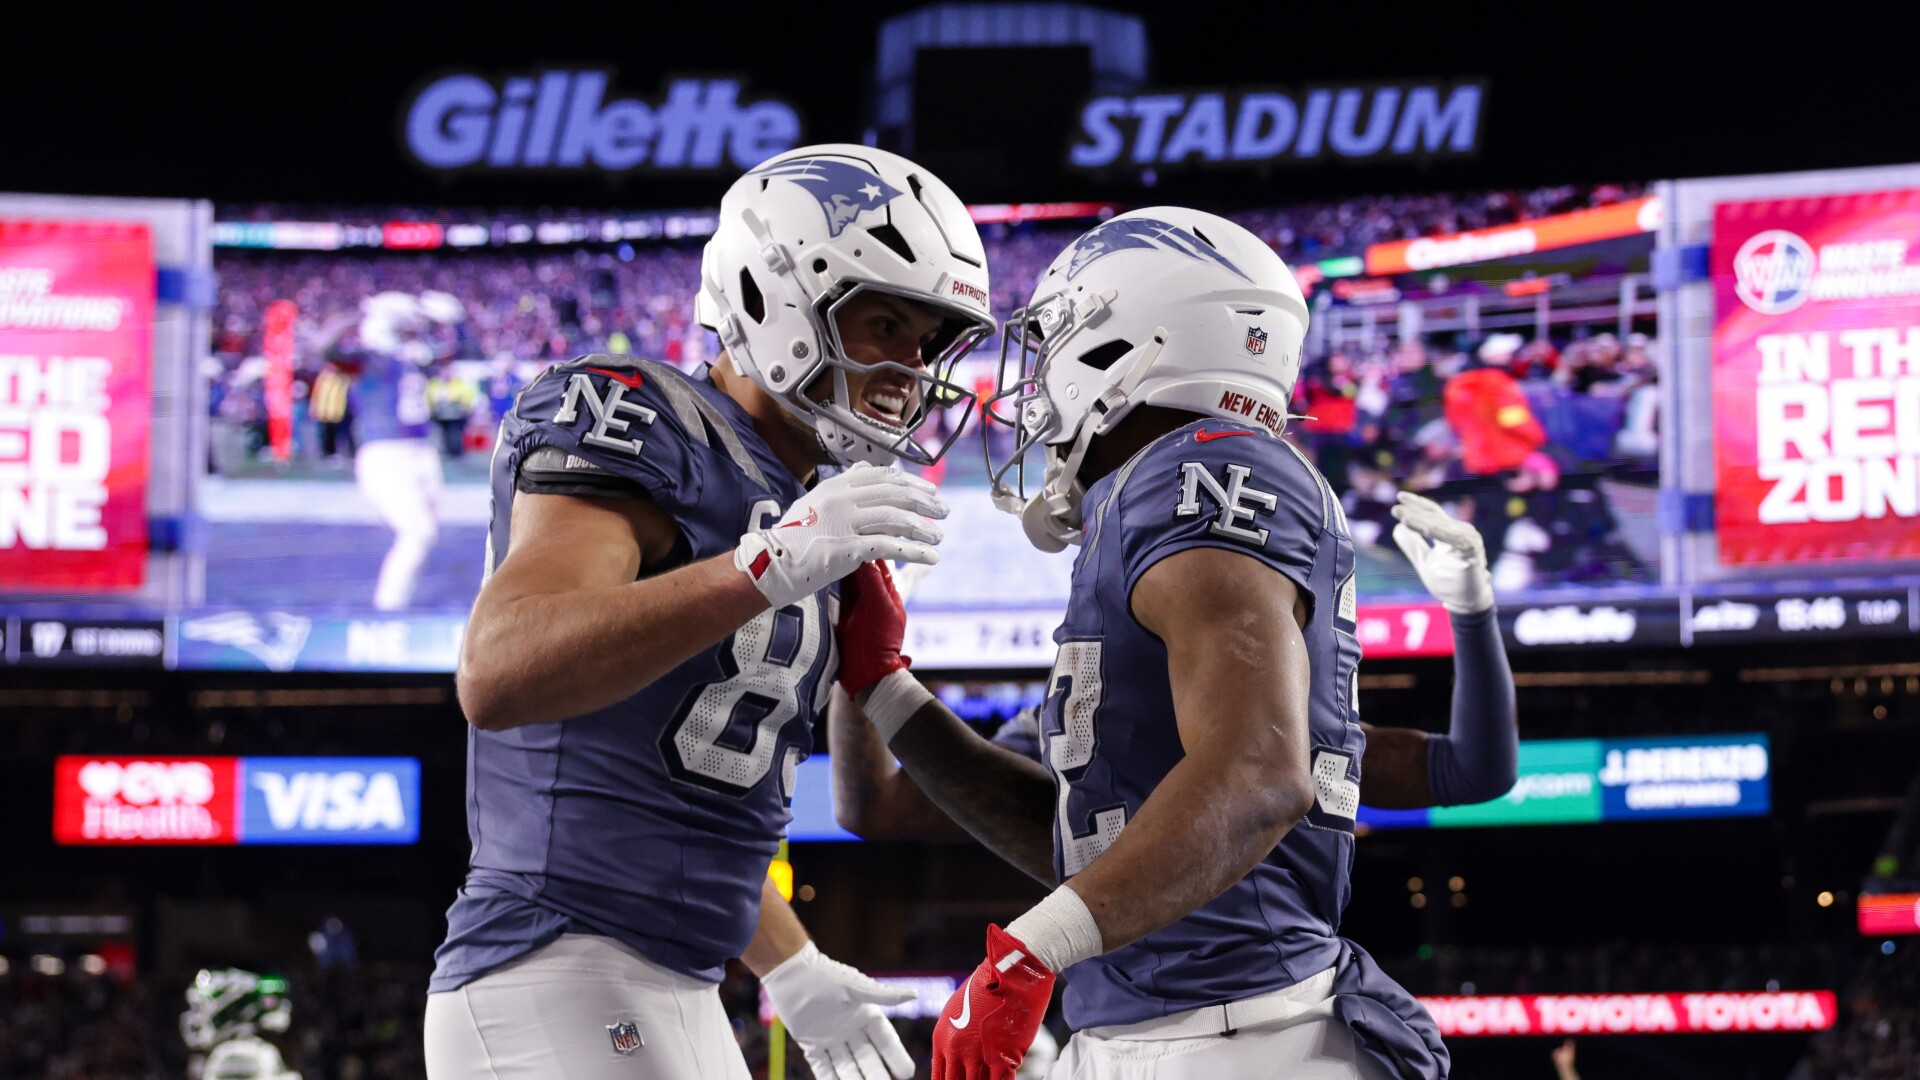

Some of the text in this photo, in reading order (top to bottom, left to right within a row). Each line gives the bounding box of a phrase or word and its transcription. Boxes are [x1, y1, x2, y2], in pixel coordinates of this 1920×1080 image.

[405, 70, 800, 170] Gillette
[1069, 86, 1483, 167] STADIUM
[952, 280, 987, 307] PATRIOTS
[1247, 336, 1264, 353] NFL
[1757, 334, 1829, 383] IN
[553, 373, 657, 456] NE
[1218, 391, 1257, 416] NEW
[1176, 462, 1278, 547] NE
[121, 761, 215, 803] CVS
[253, 772, 406, 830] VISA
[82, 799, 218, 840] Health
[1534, 995, 1679, 1034] TOYOTA
[1682, 992, 1828, 1032] TOYOTA
